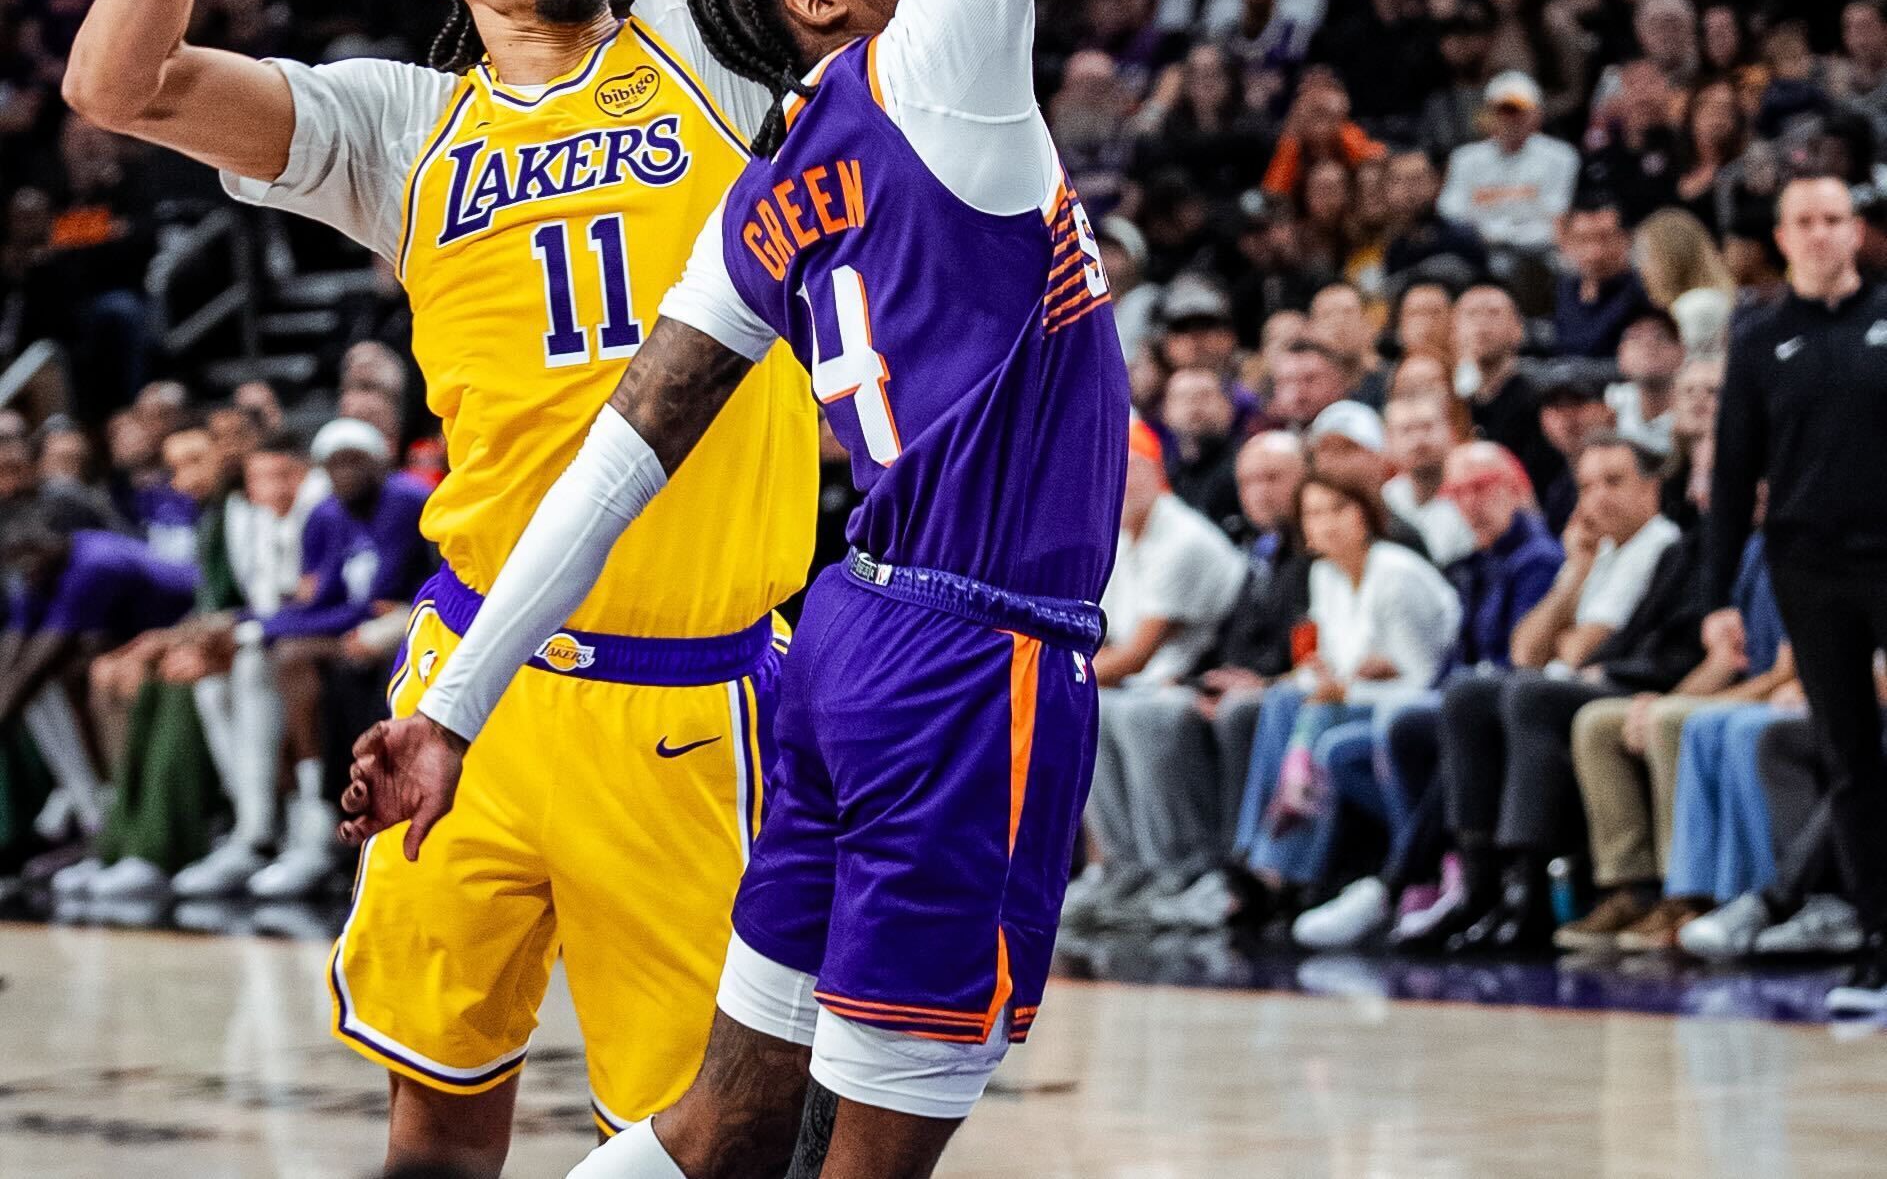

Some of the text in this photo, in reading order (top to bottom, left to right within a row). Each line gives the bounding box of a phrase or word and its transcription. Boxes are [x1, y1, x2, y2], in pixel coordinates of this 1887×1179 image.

[600, 73, 655, 105] bibigo
[437, 114, 692, 249] LAKERS
[743, 160, 865, 281] GREEN
[530, 212, 645, 369] 11
[796, 264, 902, 468] 4
[537, 640, 595, 667] LAKERS
